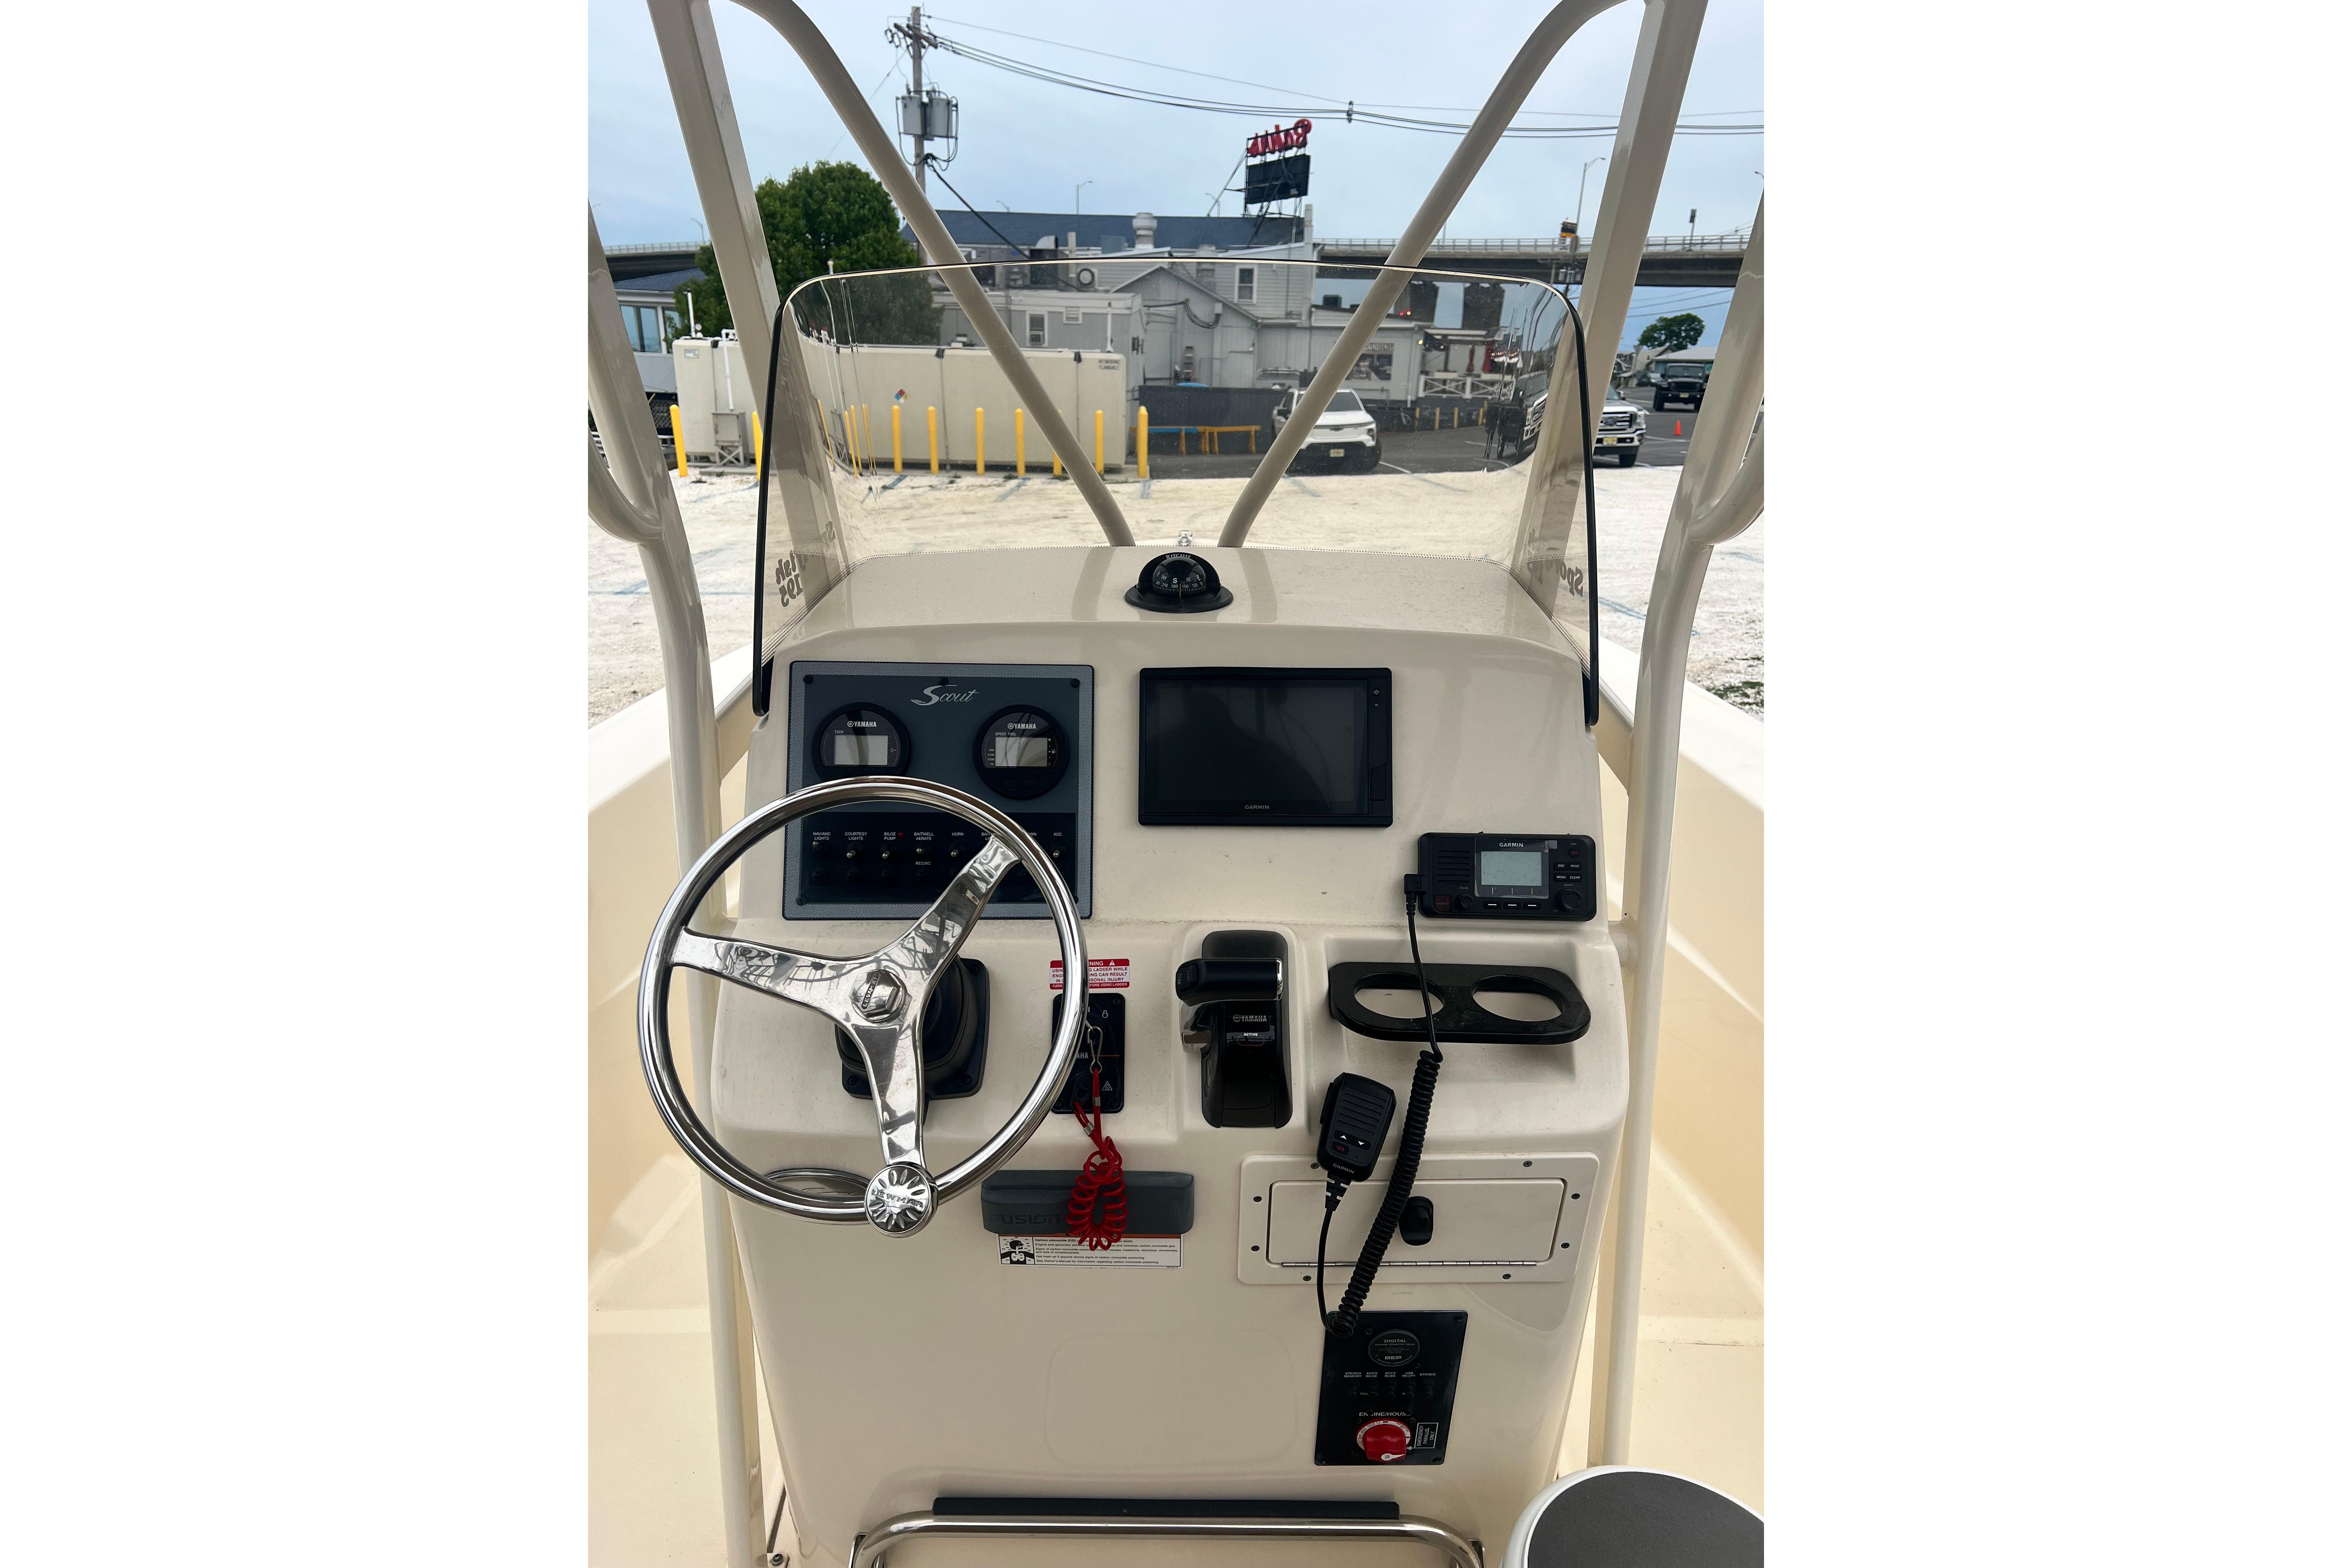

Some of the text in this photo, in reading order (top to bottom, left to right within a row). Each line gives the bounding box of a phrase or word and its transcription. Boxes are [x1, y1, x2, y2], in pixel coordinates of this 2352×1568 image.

[910, 685, 980, 706] Scout
[1333, 1163, 1354, 1174] GARMIN
[872, 1189, 924, 1208] LEWMAR
